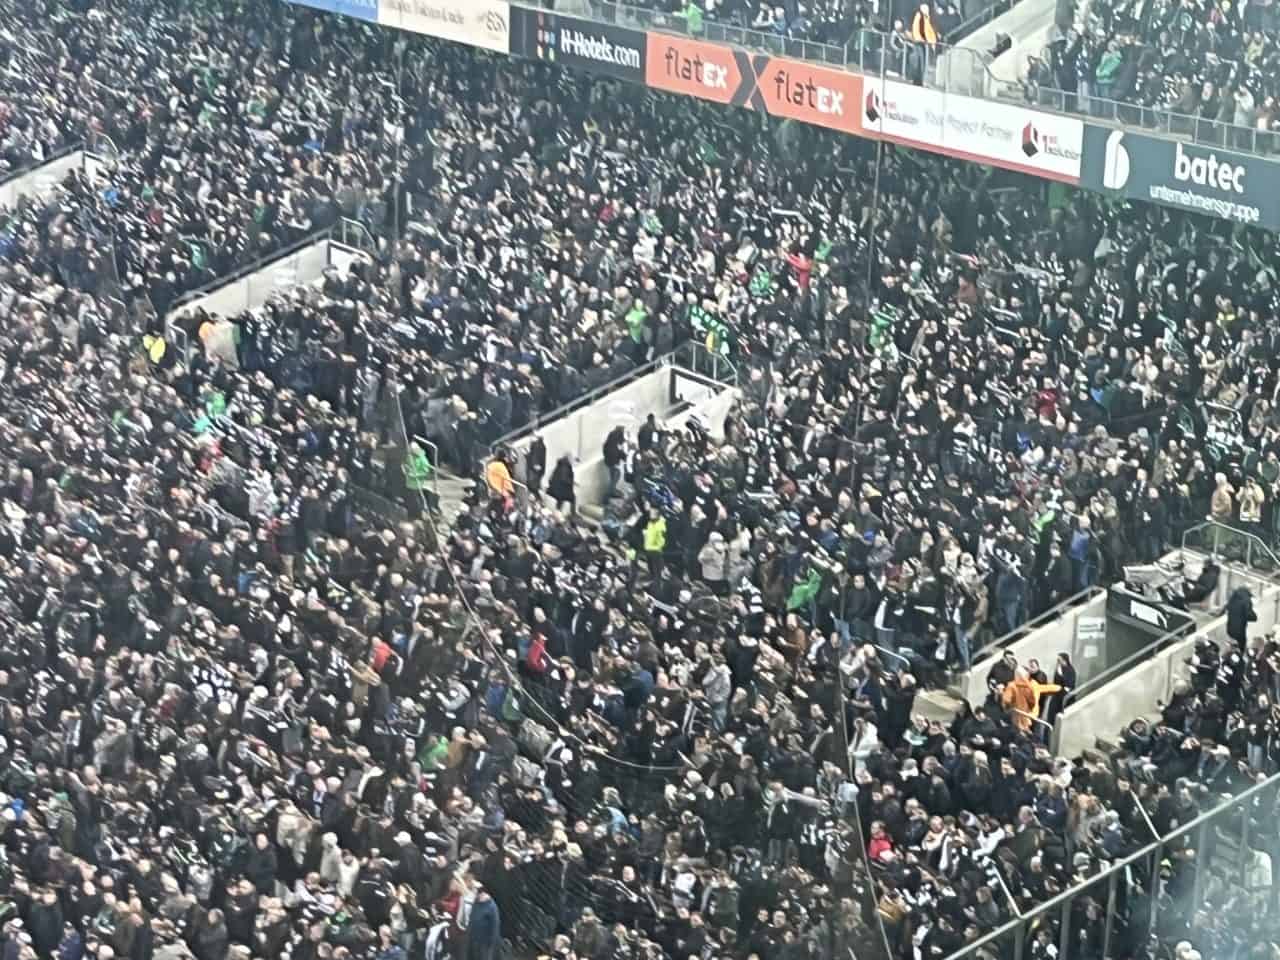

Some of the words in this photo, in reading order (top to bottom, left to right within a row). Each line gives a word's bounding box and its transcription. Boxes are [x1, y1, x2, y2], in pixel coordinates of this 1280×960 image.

[560, 28, 641, 69] H-Hotels.com
[664, 46, 728, 89] flatEX
[773, 69, 844, 115] flatEX
[1174, 141, 1246, 193] batec
[1150, 185, 1260, 223] unternehmensgruppe
